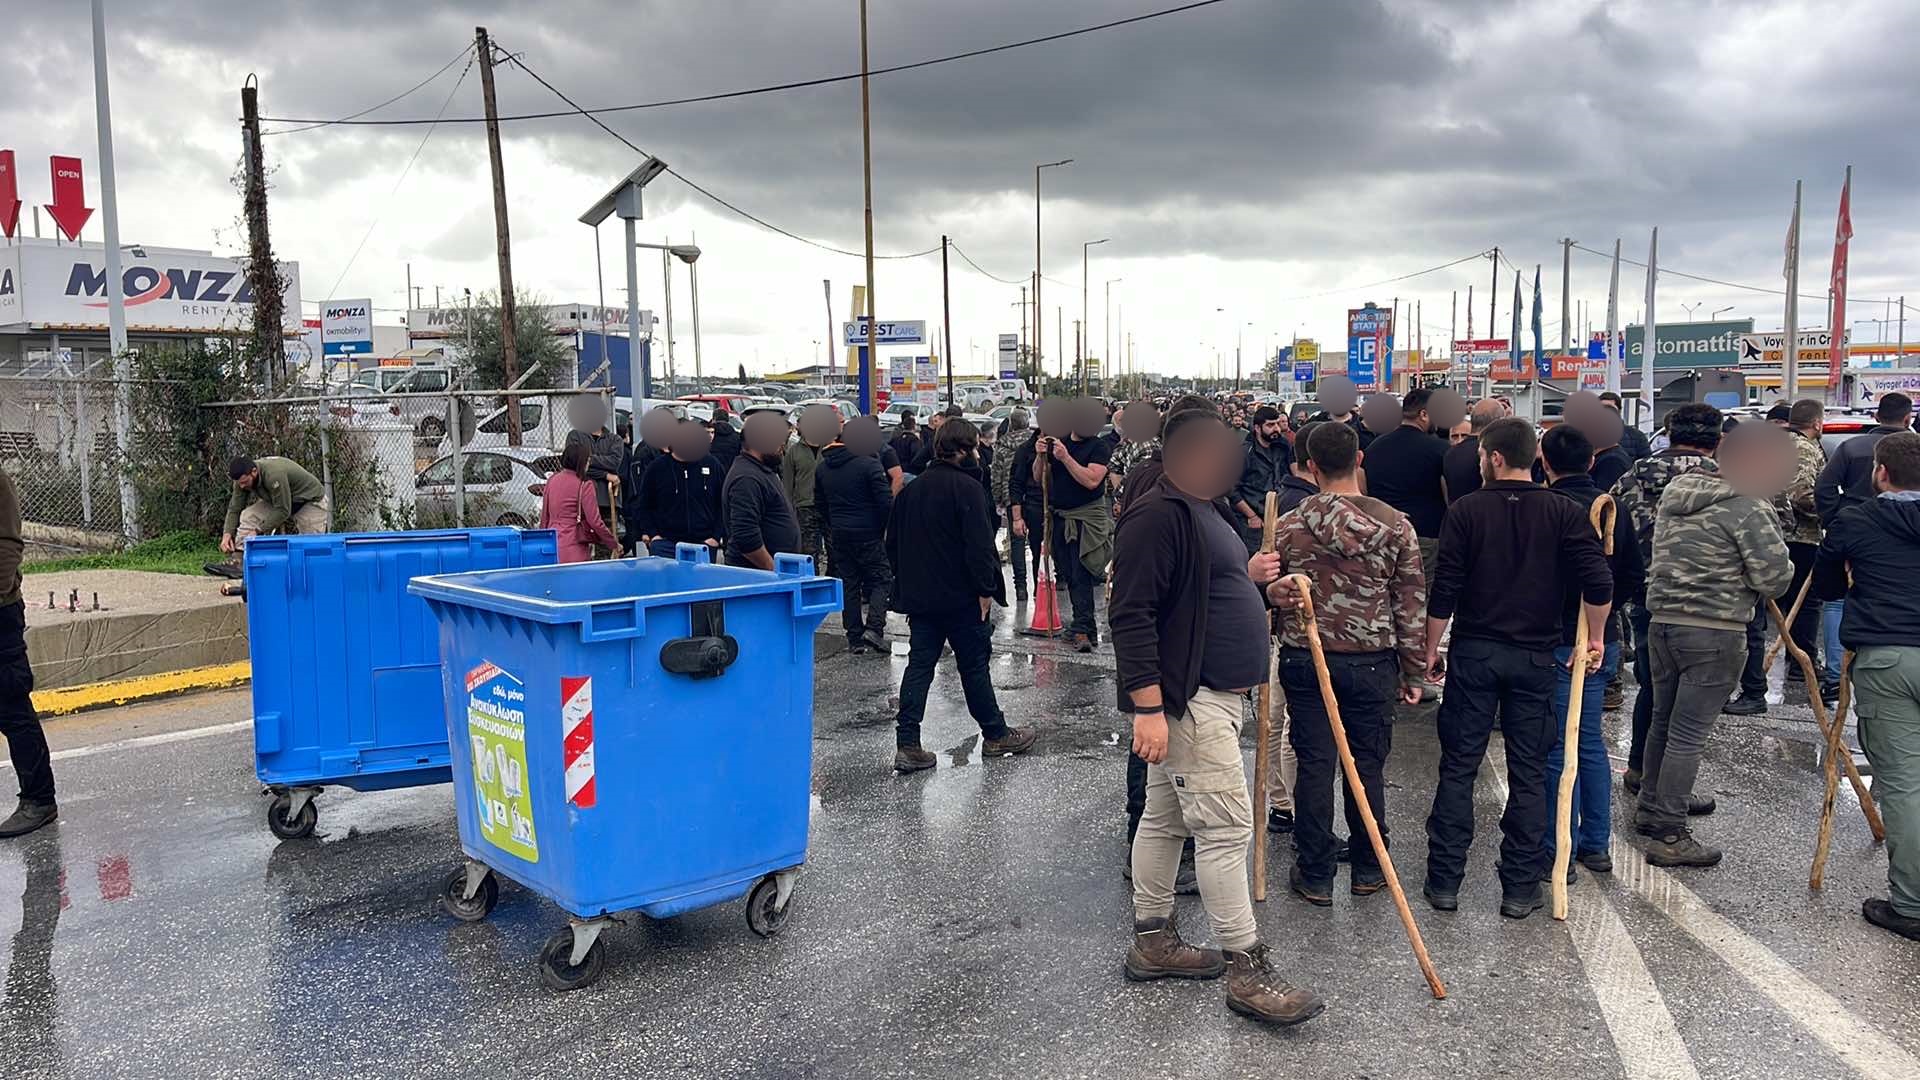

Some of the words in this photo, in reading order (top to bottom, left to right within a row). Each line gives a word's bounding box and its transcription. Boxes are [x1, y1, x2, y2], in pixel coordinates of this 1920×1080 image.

[58, 169, 80, 179] OPEN
[326, 308, 366, 319] MONZA
[1631, 330, 1740, 356] atomattis
[1807, 333, 1817, 345] in
[1875, 379, 1902, 391] Voyager
